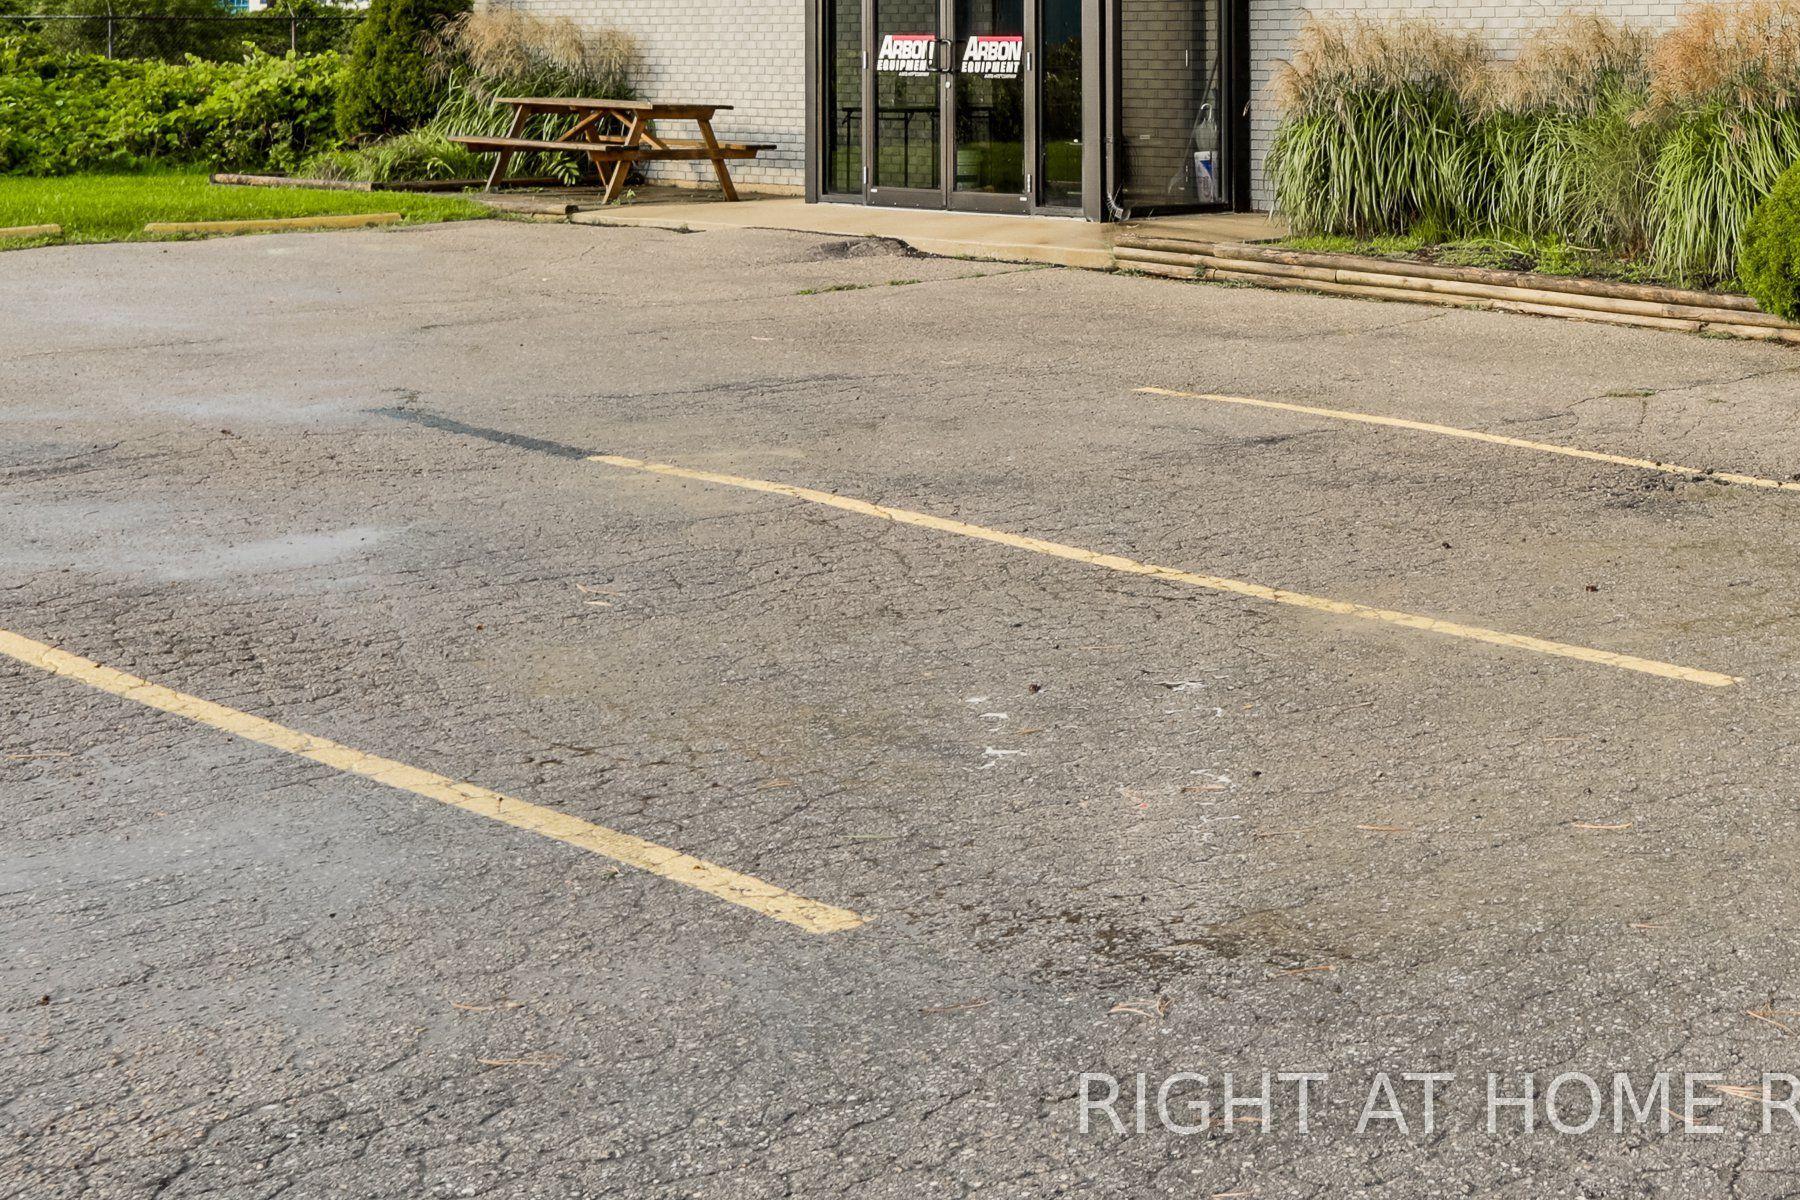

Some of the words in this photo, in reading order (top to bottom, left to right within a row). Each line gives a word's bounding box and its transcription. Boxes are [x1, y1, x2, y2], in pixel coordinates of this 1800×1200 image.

[963, 36, 1022, 61] ARBON
[877, 60, 933, 71] EQUIPMEN
[961, 61, 1020, 73] EQUIPMENT
